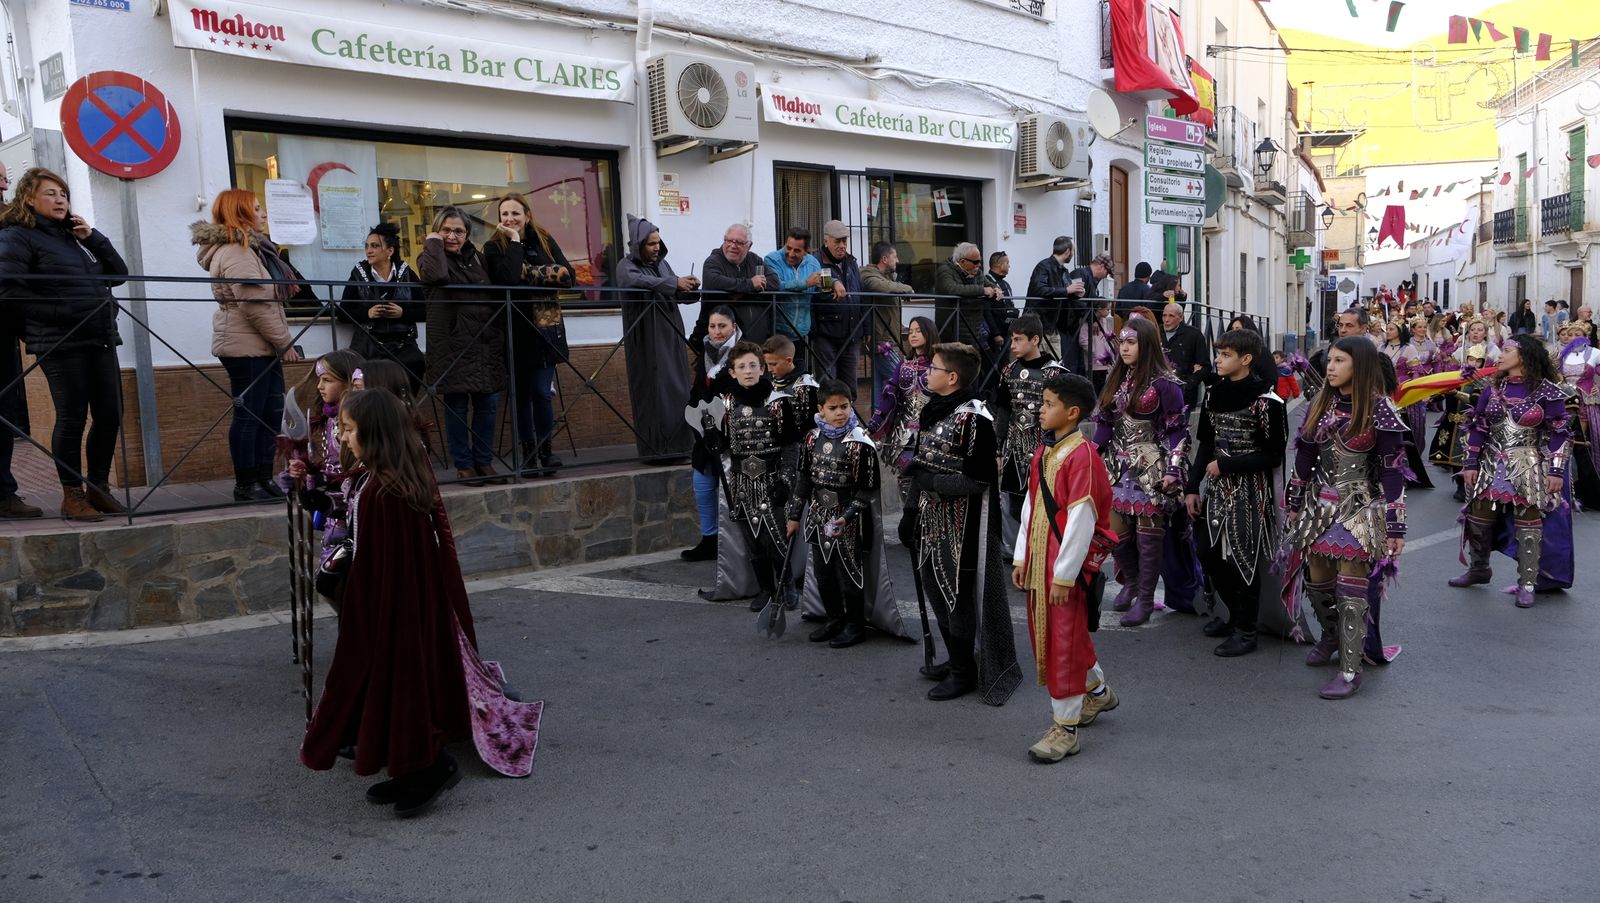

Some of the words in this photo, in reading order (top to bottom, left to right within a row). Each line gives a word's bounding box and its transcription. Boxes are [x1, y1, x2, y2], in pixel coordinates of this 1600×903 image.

[190, 8, 286, 42] Mahou
[311, 28, 452, 72] Cafetería
[460, 48, 506, 78] Bar
[513, 57, 621, 91] CLARES
[771, 94, 822, 116] Mahou
[835, 104, 913, 133] Cafetería
[919, 115, 945, 136] Bar
[949, 119, 1013, 144] CLARES
[1148, 121, 1167, 132] Iglesia
[1149, 145, 1171, 155] Registro
[1149, 155, 1156, 163] de
[1159, 156, 1164, 164] la
[1166, 159, 1193, 168] propiedad
[1149, 175, 1181, 186] Consultorio
[1151, 206, 1188, 217] Ayuntamiento
